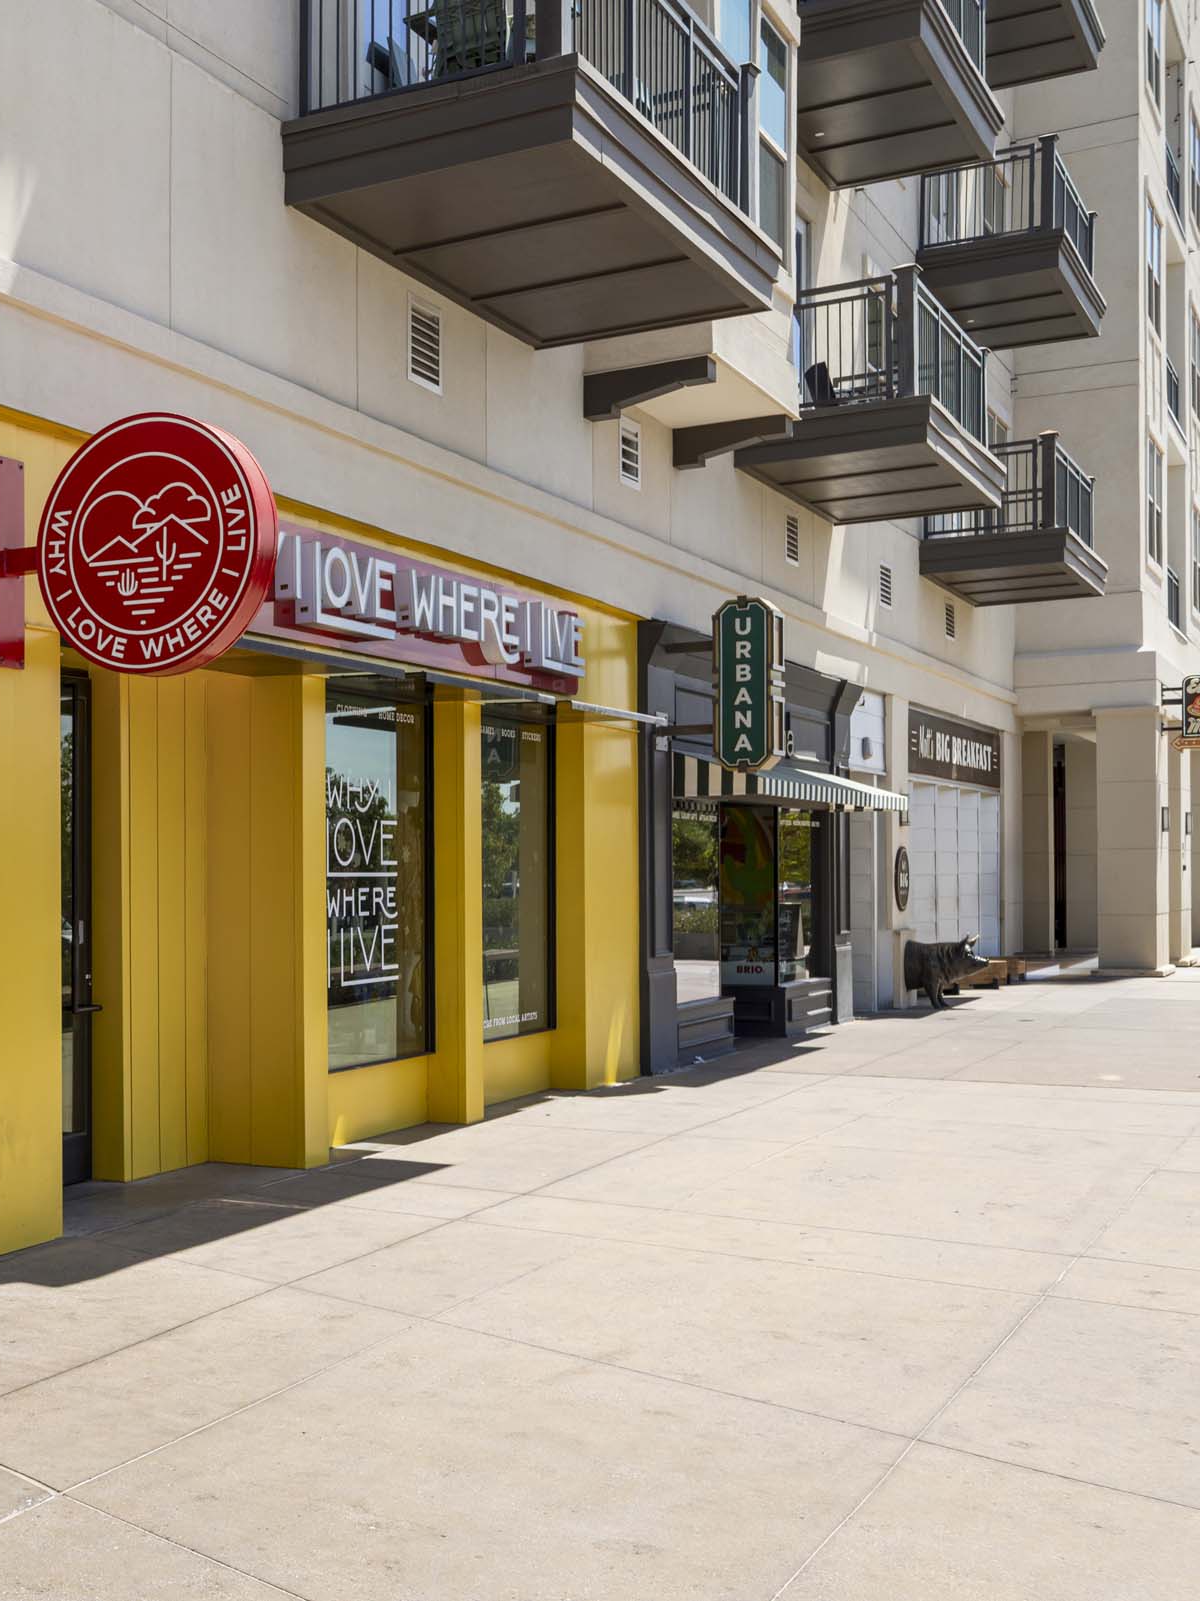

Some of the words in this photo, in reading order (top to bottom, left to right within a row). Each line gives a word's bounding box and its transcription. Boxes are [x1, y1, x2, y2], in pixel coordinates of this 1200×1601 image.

[220, 483, 247, 551] LIVE
[47, 509, 73, 576] WHY
[56, 589, 73, 602] I
[221, 567, 240, 578] I
[66, 606, 128, 660] LOVE
[139, 587, 229, 660] WHERE
[315, 541, 397, 640] LOVE
[411, 569, 520, 665] WHERE
[541, 600, 585, 678] LIVE
[734, 617, 753, 752] URBANA
[378, 711, 395, 721] HOME
[396, 712, 415, 724] DECOR
[501, 727, 516, 738] BOOKS
[935, 731, 950, 763] BIG
[951, 736, 992, 772] BREAKFAST
[326, 773, 380, 813] WHY
[326, 817, 398, 877] LOVE
[326, 886, 398, 919] WHERE
[340, 924, 399, 987] LIVE
[736, 965, 764, 975] BRIO
